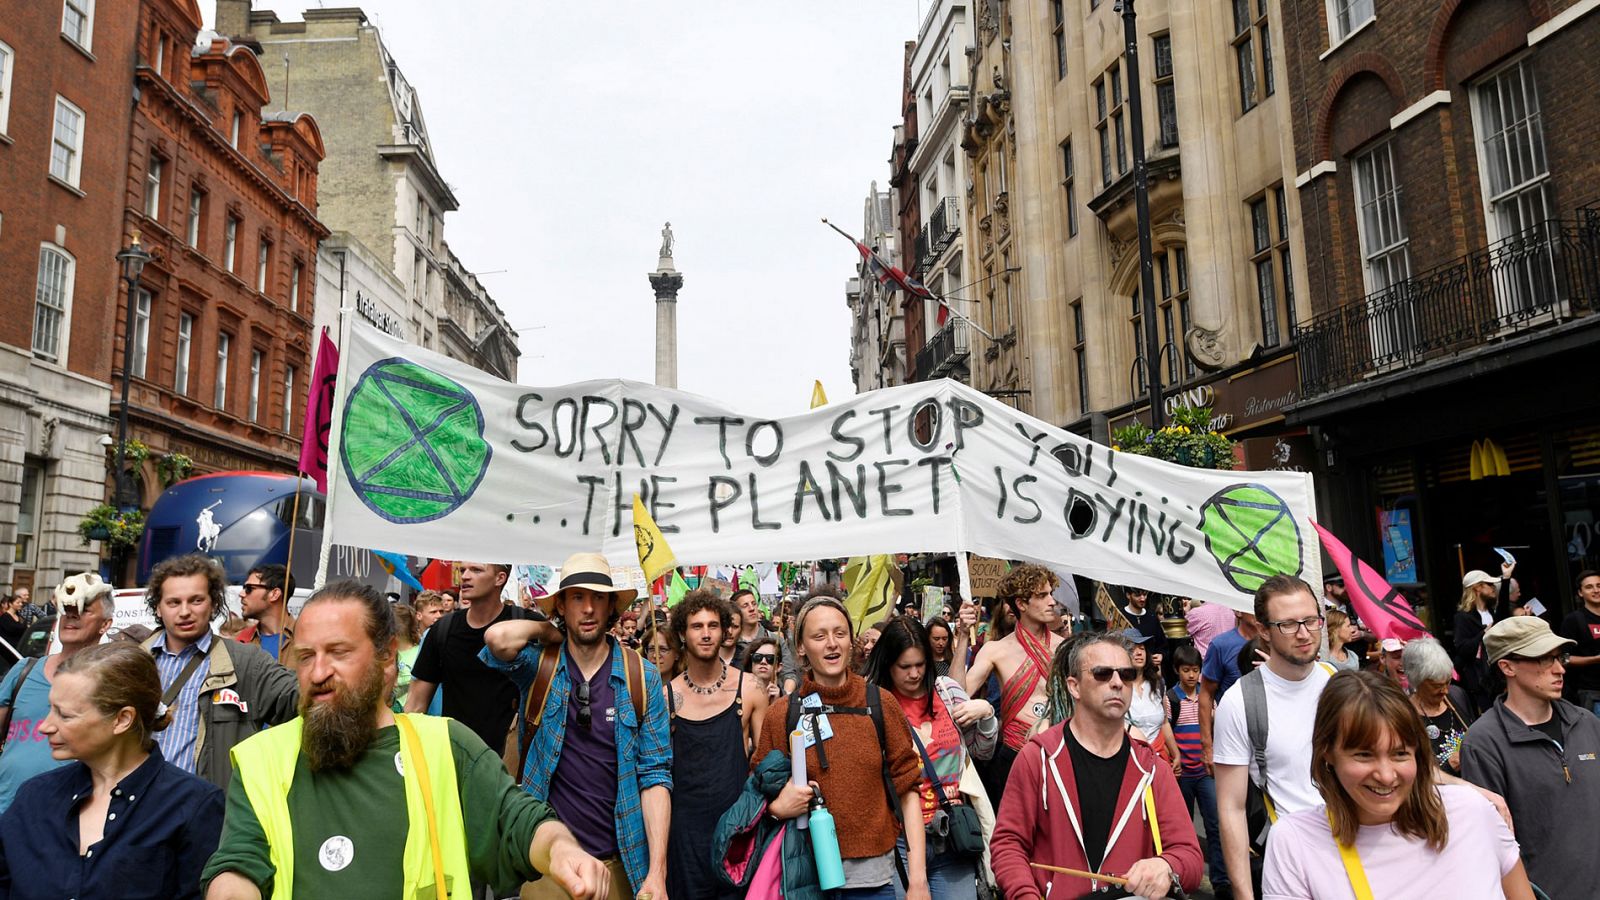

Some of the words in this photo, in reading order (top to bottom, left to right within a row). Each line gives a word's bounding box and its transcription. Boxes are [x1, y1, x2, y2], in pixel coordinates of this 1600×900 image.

[1243, 389, 1297, 417] Ristorante
[509, 392, 681, 469] SORRY
[693, 415, 785, 470] TO
[826, 396, 985, 463] STOP
[707, 456, 953, 534] PLANET
[994, 465, 1043, 525] IS
[1063, 486, 1196, 566] DYING
[970, 563, 1002, 577] SOCIAL
